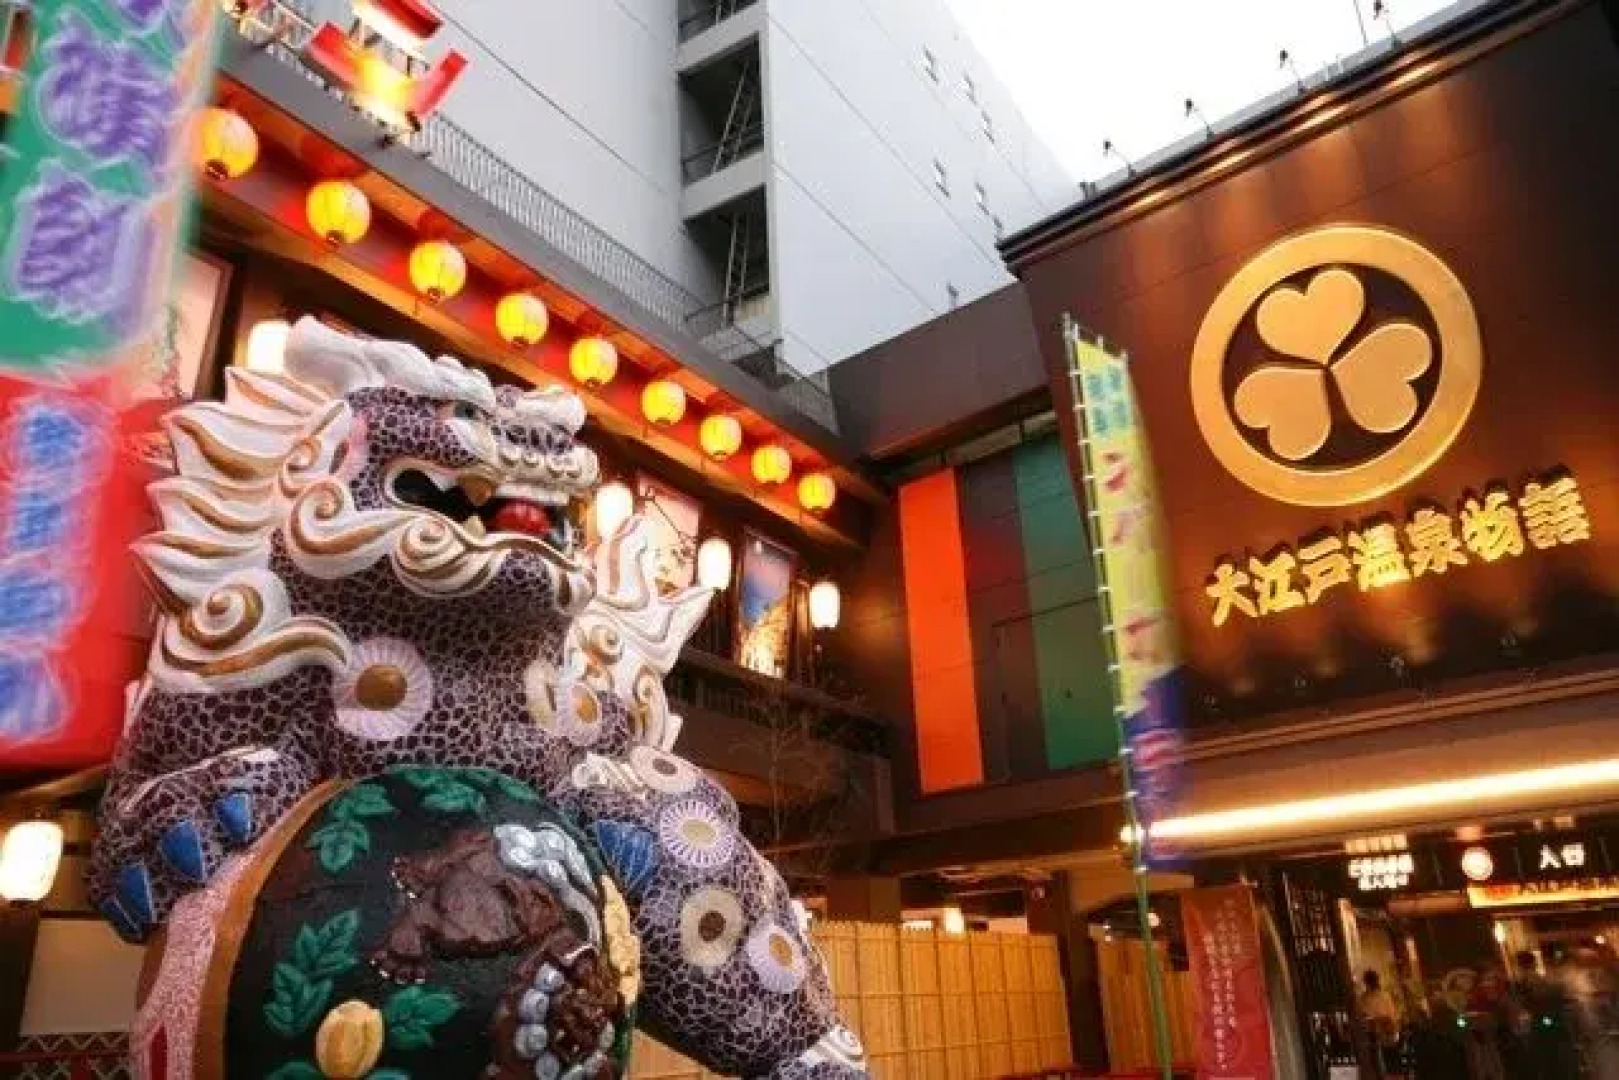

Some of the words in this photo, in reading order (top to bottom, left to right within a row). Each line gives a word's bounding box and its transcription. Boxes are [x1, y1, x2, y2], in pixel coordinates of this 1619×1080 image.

[1206, 476, 1591, 628] 大江戸温泉物語
